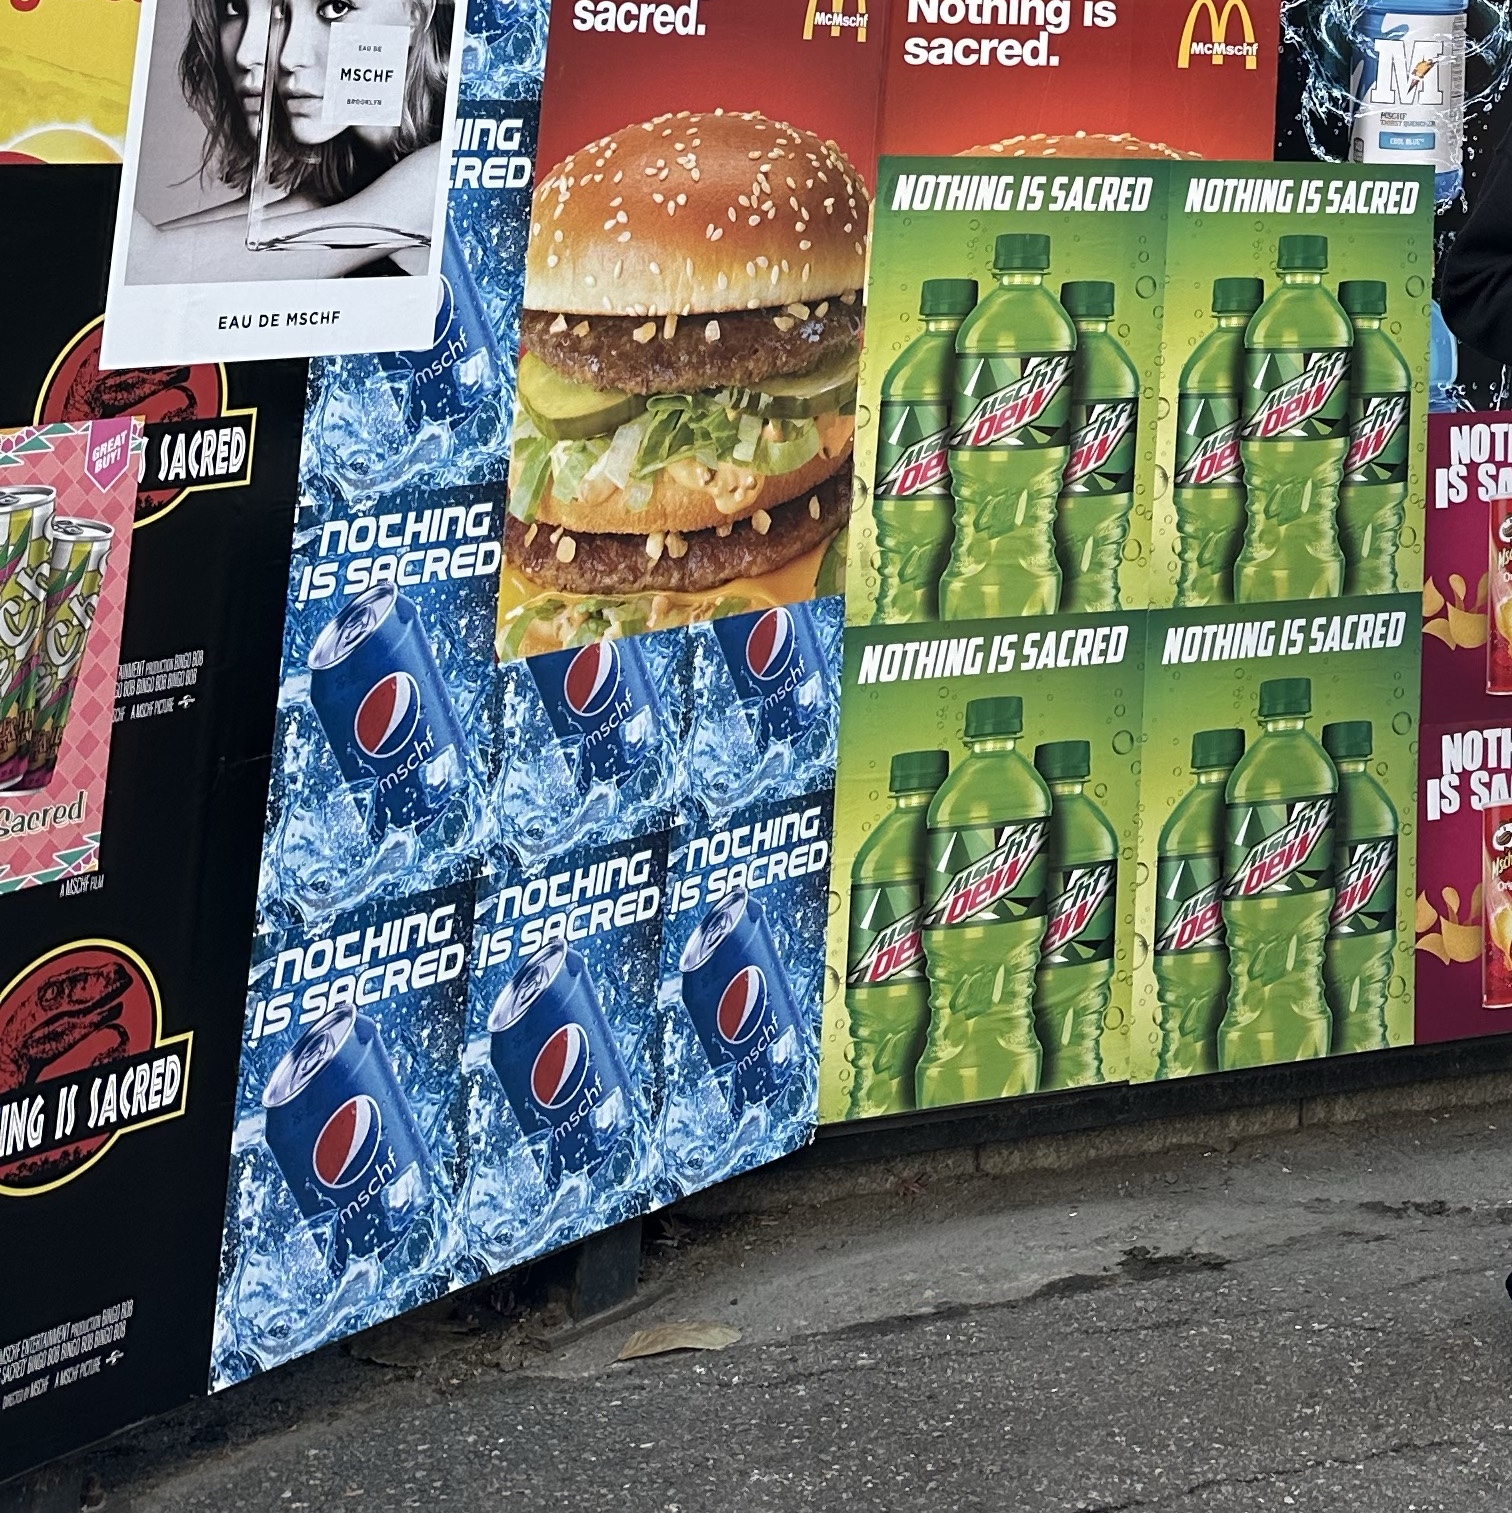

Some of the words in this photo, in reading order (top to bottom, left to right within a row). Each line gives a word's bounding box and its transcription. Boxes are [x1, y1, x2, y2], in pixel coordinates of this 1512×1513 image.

[813, 9, 869, 30] McMschf
[340, 67, 394, 83] MSCHF
[904, 31, 1060, 68] sacred.
[1190, 38, 1259, 59] McMschf
[891, 173, 1015, 212] NOTHING
[1015, 175, 1046, 212] IS
[1047, 176, 1153, 213] SACRED
[1184, 178, 1295, 215] NOTHING
[1296, 180, 1323, 214] IS
[1325, 180, 1420, 216] SACRED
[218, 314, 252, 330] EAU
[258, 312, 280, 328] DE
[286, 309, 341, 327] MSCHF
[92, 429, 128, 461] GREAT
[94, 450, 121, 474] BUY!
[158, 426, 247, 481] SACRED
[1435, 464, 1469, 509] IS
[318, 502, 493, 558] NOTHING
[299, 564, 337, 604] IS
[346, 540, 502, 596] SACRED
[857, 639, 984, 685] NOTHING
[987, 635, 1018, 675] IS
[1021, 625, 1130, 672] SACRED
[1162, 620, 1275, 665] NOTHING
[1278, 618, 1307, 656] IS
[1308, 611, 1407, 653] SACRED
[379, 729, 436, 794] mschf
[0, 790, 87, 838] Sacred
[1427, 773, 1461, 821] IS
[685, 806, 822, 872] NOTHING
[495, 849, 653, 923] NOTHING
[670, 876, 702, 913] IS
[705, 841, 829, 903] SACRED
[272, 904, 456, 989] NOTHING
[477, 932, 513, 970] IS
[517, 886, 660, 948] SACRED
[251, 999, 292, 1040] IS
[299, 942, 467, 1024] SACRED
[54, 1084, 79, 1140] IS
[87, 1054, 182, 1129] SACRED
[340, 1150, 399, 1225] mschf
